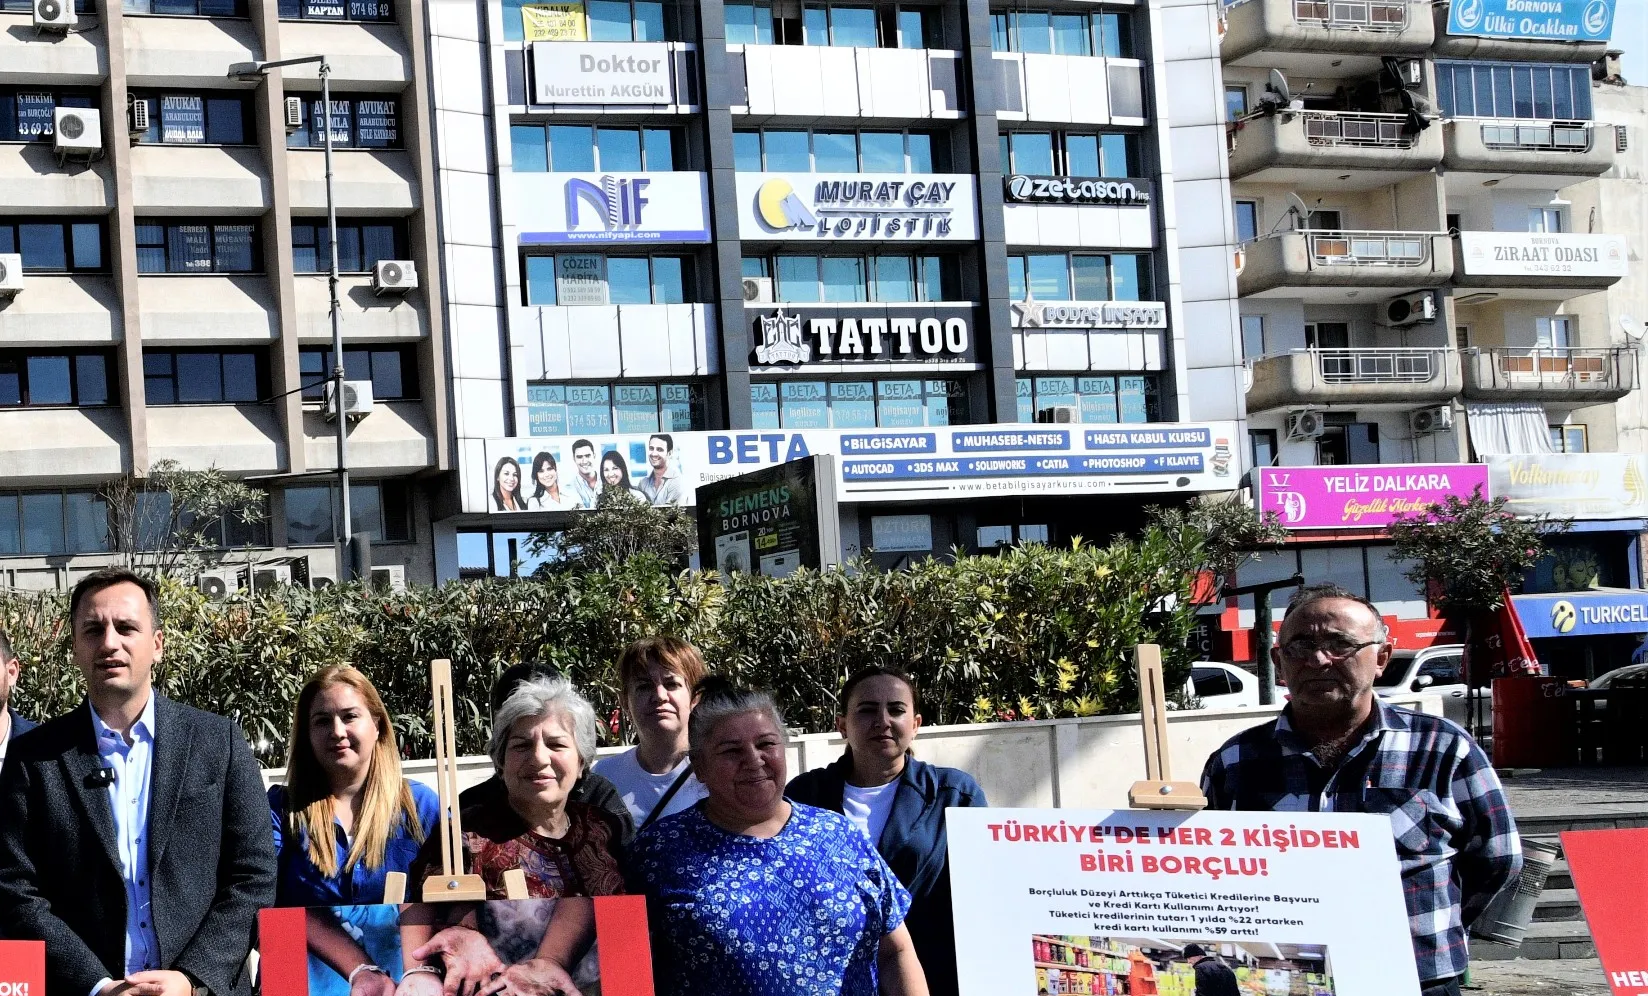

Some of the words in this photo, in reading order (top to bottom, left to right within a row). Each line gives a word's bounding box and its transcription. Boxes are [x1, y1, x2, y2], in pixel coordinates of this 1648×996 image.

[352, 2, 366, 15] 374
[367, 3, 378, 16] 65
[379, 3, 389, 16] 42
[579, 54, 661, 73] Doktor
[544, 84, 605, 97] Nurettin
[611, 82, 664, 97] AKGÜN
[163, 96, 201, 111] AVUKAT
[358, 100, 395, 115] AVUKAT
[165, 112, 202, 121] ARABULUCU
[359, 118, 396, 127] ARABULUCU
[819, 181, 904, 203] MURAT
[909, 181, 956, 206] ÇAY
[179, 225, 207, 233] SERBEST
[821, 213, 952, 232] LOJİSTİK
[567, 231, 660, 240] www.nifyapi.com
[1555, 247, 1599, 262] ODASI
[562, 256, 597, 272] ÇÖZEN
[561, 271, 600, 285] HARİTA
[810, 318, 968, 354] TATTOO
[572, 389, 603, 401] BETA
[621, 387, 652, 400] BETA
[788, 385, 819, 398] BETA
[838, 384, 867, 397] BETA
[884, 383, 914, 396] BETA
[1094, 433, 1128, 444] HASTA
[1130, 432, 1166, 444] KABUL
[1168, 431, 1205, 443] KURSU
[707, 433, 811, 464] BETA
[851, 463, 894, 475] AUTOCAD
[914, 462, 934, 473] 3DS
[935, 461, 960, 472] MAX
[1042, 459, 1069, 469] CATIA
[1088, 457, 1146, 468] PHOTOSHOP
[1159, 456, 1165, 467] F
[1166, 455, 1200, 467] KLAVYE
[959, 479, 1106, 491] www.betabilgisayarkursu.com
[1323, 472, 1370, 493] YELİZ
[1373, 473, 1451, 492] DALKARA
[720, 485, 791, 518] SIEMENS
[722, 504, 790, 531] BORNOVA
[1341, 498, 1386, 522] Güzellik
[987, 820, 1151, 845] TÜRKİYE'DE
[1157, 826, 1213, 846] HER
[1219, 828, 1237, 846] 2
[1243, 823, 1360, 852] KİŞİDEN
[1080, 848, 1134, 873] BİRİ
[1141, 855, 1269, 880] BORÇLU!
[1028, 887, 1078, 897] Borçluluk
[1080, 888, 1117, 899] Düzeyi
[1118, 890, 1163, 900] Arttıkça
[1165, 890, 1208, 900] Tüketici
[1210, 892, 1271, 902] Kredilerine
[1273, 894, 1320, 905] Başvuru
[1103, 900, 1132, 909] Kredi
[1134, 901, 1161, 910] Kartı
[1163, 902, 1214, 912] Kullanımı
[1217, 904, 1259, 914] Artıyor!
[1049, 910, 1090, 919] Tüketici
[1093, 911, 1155, 921] kredilerinin
[1157, 914, 1188, 922] tutarı
[1191, 914, 1195, 922] 1
[1198, 914, 1226, 924] yılda
[1228, 915, 1252, 924] %22
[1254, 917, 1304, 926] artarken
[1094, 922, 1122, 931] kredi
[1124, 923, 1150, 932] kartı
[1152, 924, 1202, 934] kullanımı
[1204, 926, 1227, 934] %59
[1230, 927, 1259, 936] arttı!
